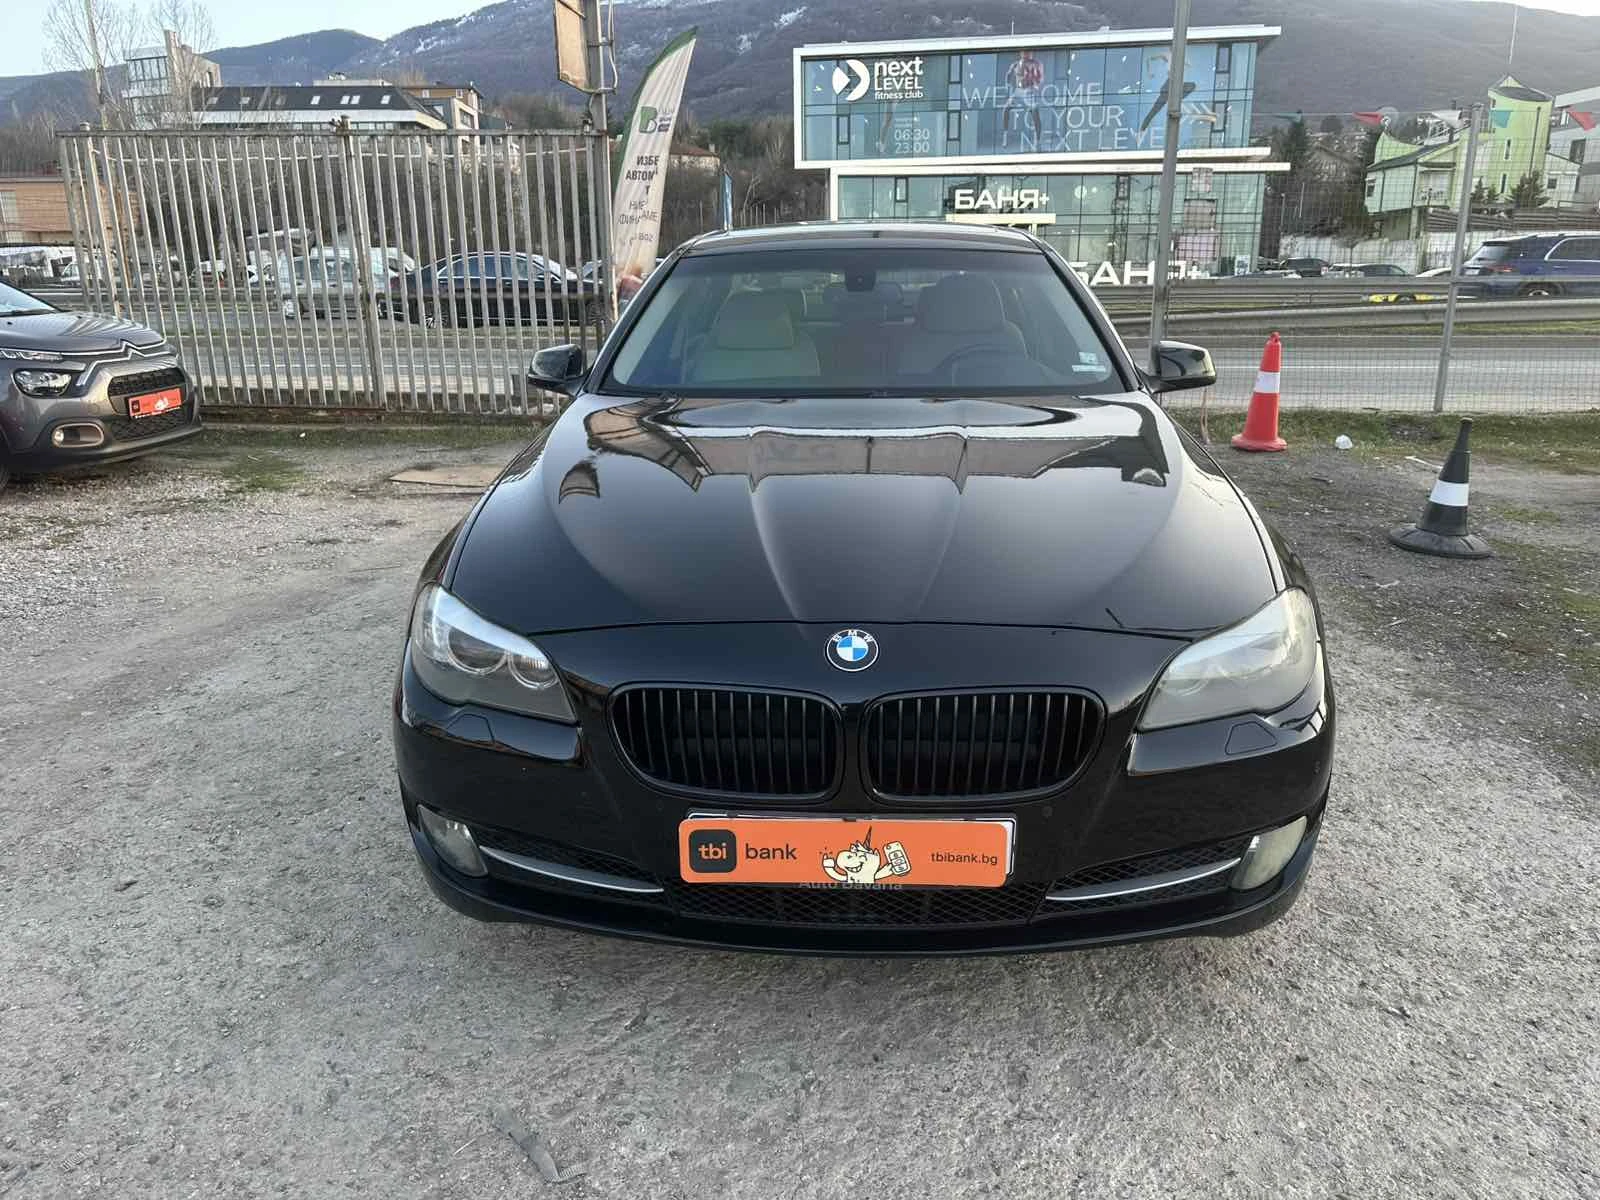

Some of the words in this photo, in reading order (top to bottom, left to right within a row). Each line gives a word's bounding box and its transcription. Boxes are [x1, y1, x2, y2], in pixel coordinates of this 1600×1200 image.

[874, 57, 924, 77] next
[874, 77, 924, 91] LEVEL
[874, 91, 903, 100] fitness
[904, 90, 924, 99] club
[962, 82, 1104, 108] WELCOME
[1052, 105, 1125, 129] YOUR
[894, 128, 930, 141] 06:30
[1097, 127, 1166, 150] LEVE
[895, 142, 930, 154] 23:00
[698, 842, 728, 860] tbi
[744, 842, 797, 861] bank
[930, 852, 998, 866] tbibank.bg
